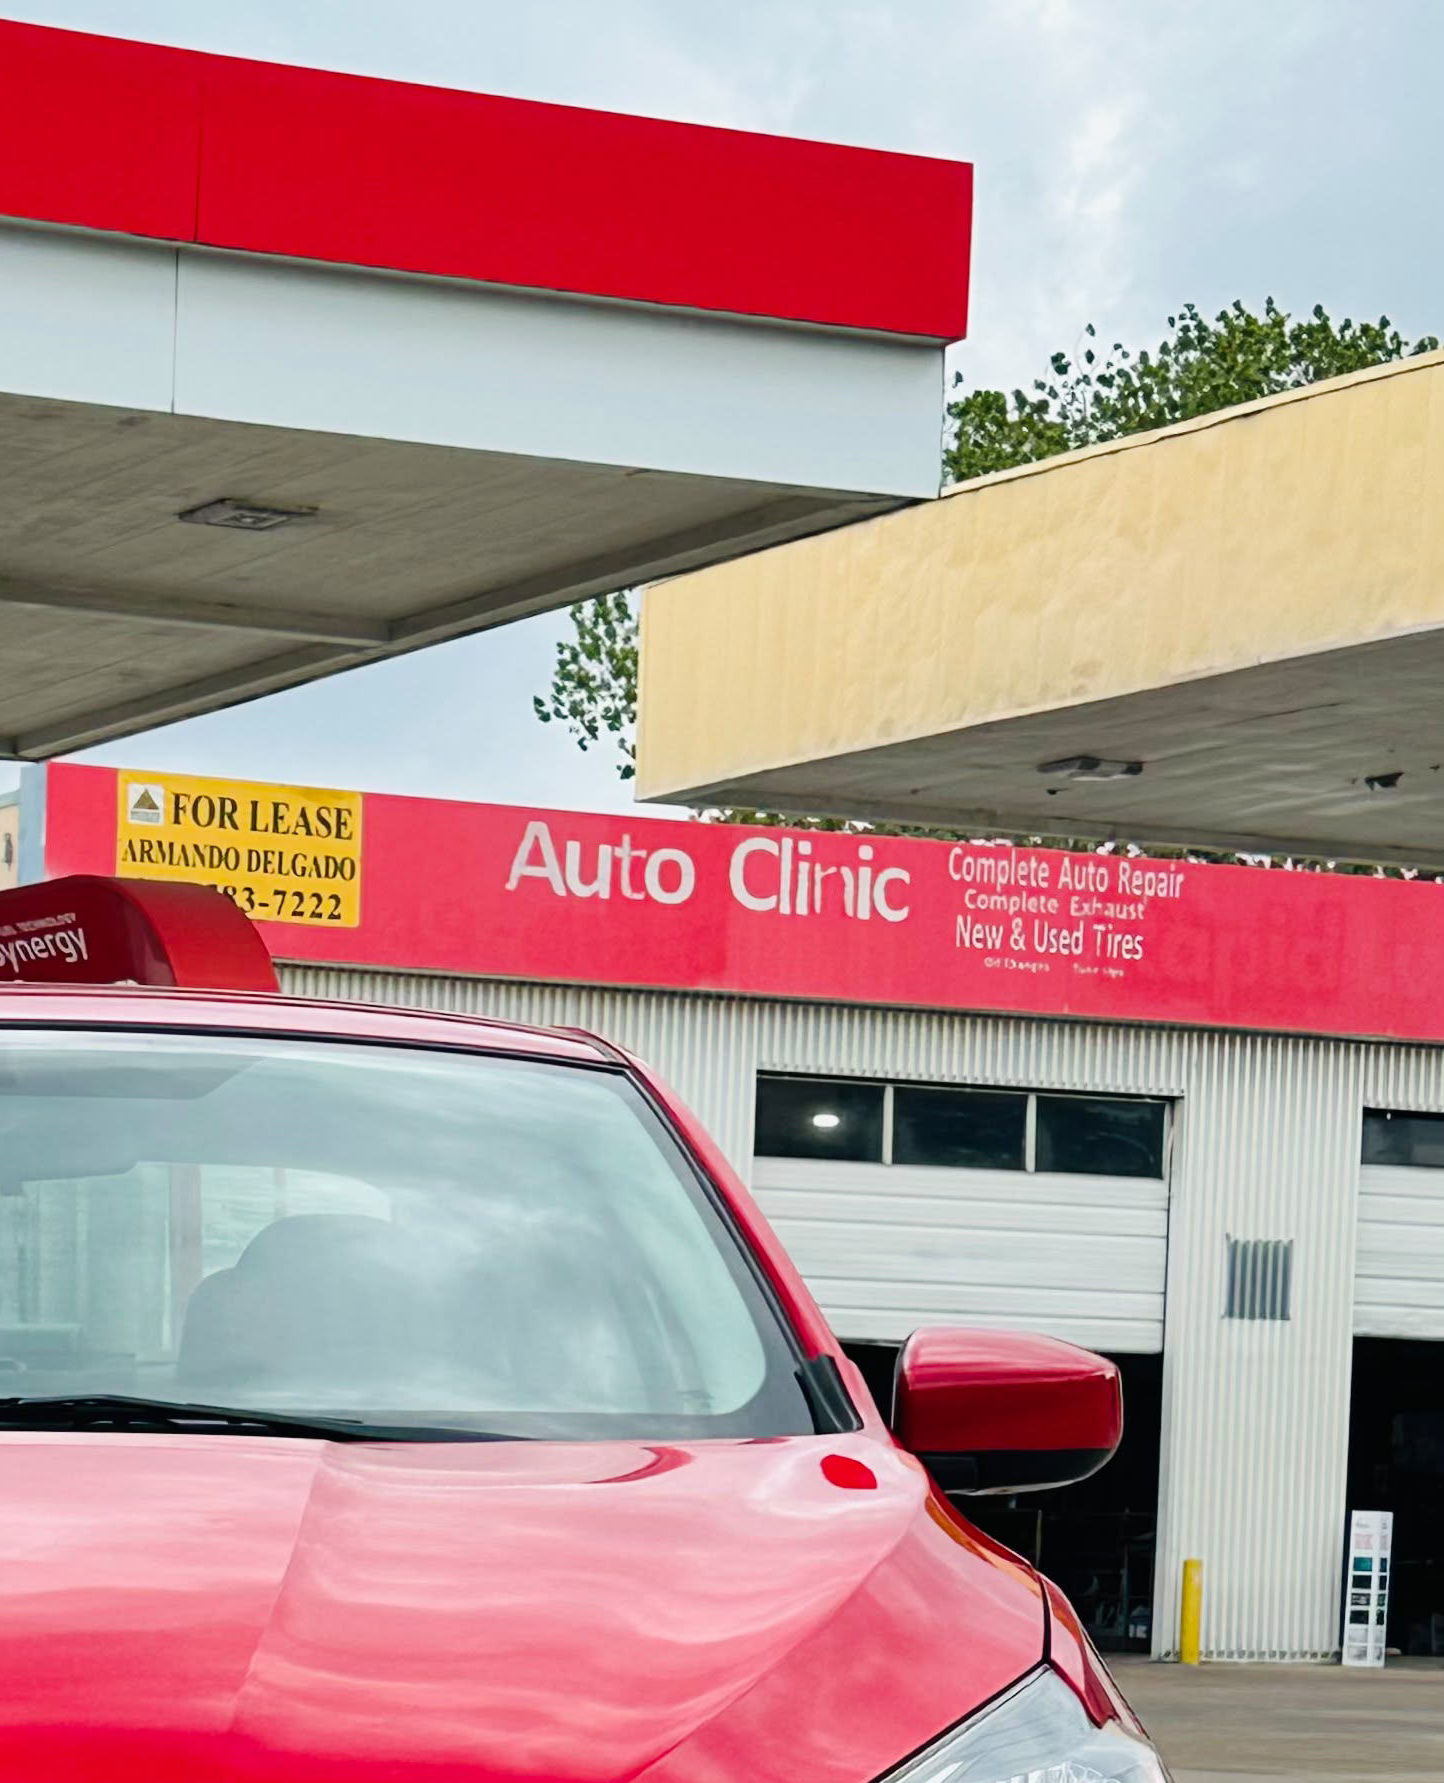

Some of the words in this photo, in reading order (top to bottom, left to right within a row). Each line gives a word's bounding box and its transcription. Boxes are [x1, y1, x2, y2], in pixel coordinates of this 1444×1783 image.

[172, 792, 239, 830] FOR
[250, 800, 353, 840] LEASE
[122, 839, 240, 872] ARMANDO
[247, 849, 355, 881] DELGADO
[505, 820, 695, 905] Auto
[729, 837, 911, 922] Clinic
[948, 847, 1050, 892] Complete
[1058, 856, 1109, 893] Auto
[1118, 862, 1185, 903] Repair
[964, 889, 1059, 916] Complete
[1069, 895, 1145, 920] Exhaust
[956, 914, 1004, 950] New
[1009, 917, 1026, 951] &
[1033, 918, 1085, 956] Used
[1092, 922, 1144, 960] Tires
